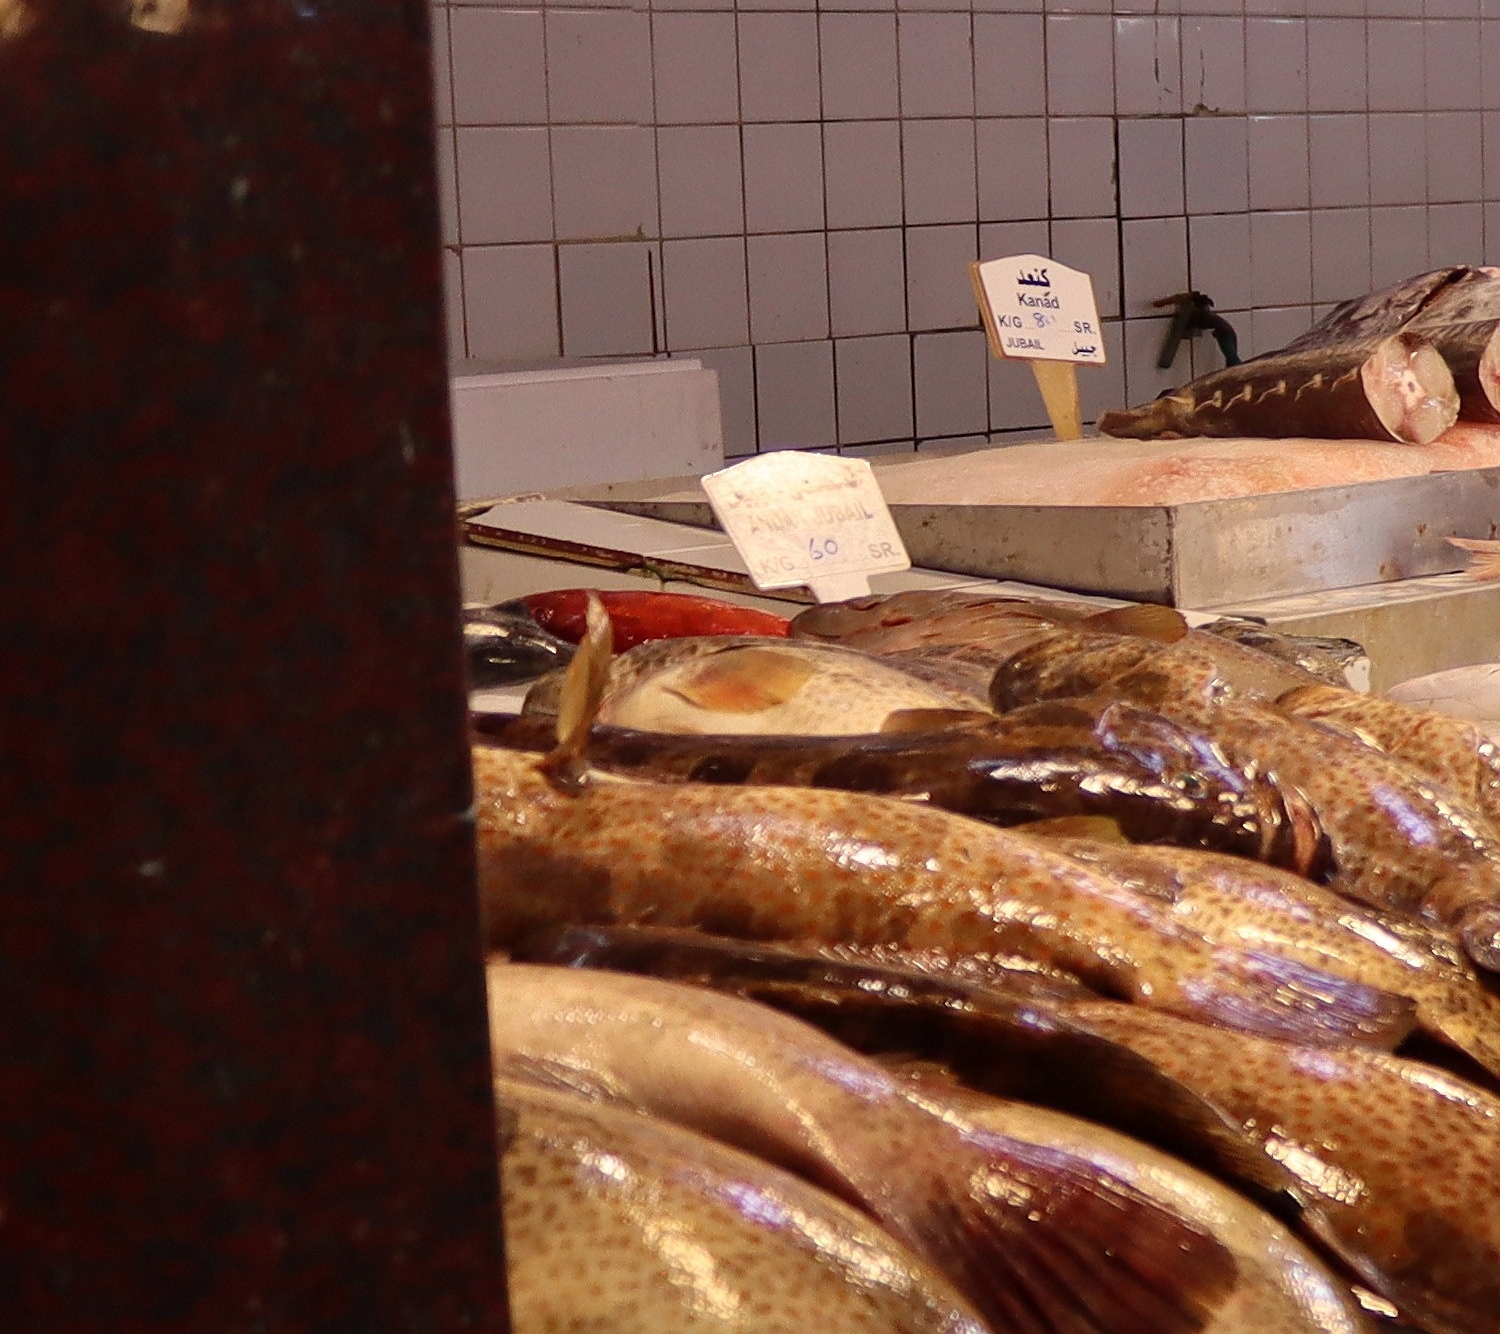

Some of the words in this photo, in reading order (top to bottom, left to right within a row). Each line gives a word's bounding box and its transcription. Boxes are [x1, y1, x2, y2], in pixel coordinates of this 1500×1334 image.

[1017, 268, 1050, 287] كنعد
[1006, 337, 1046, 350] JUBAIL
[809, 537, 838, 561] 60
